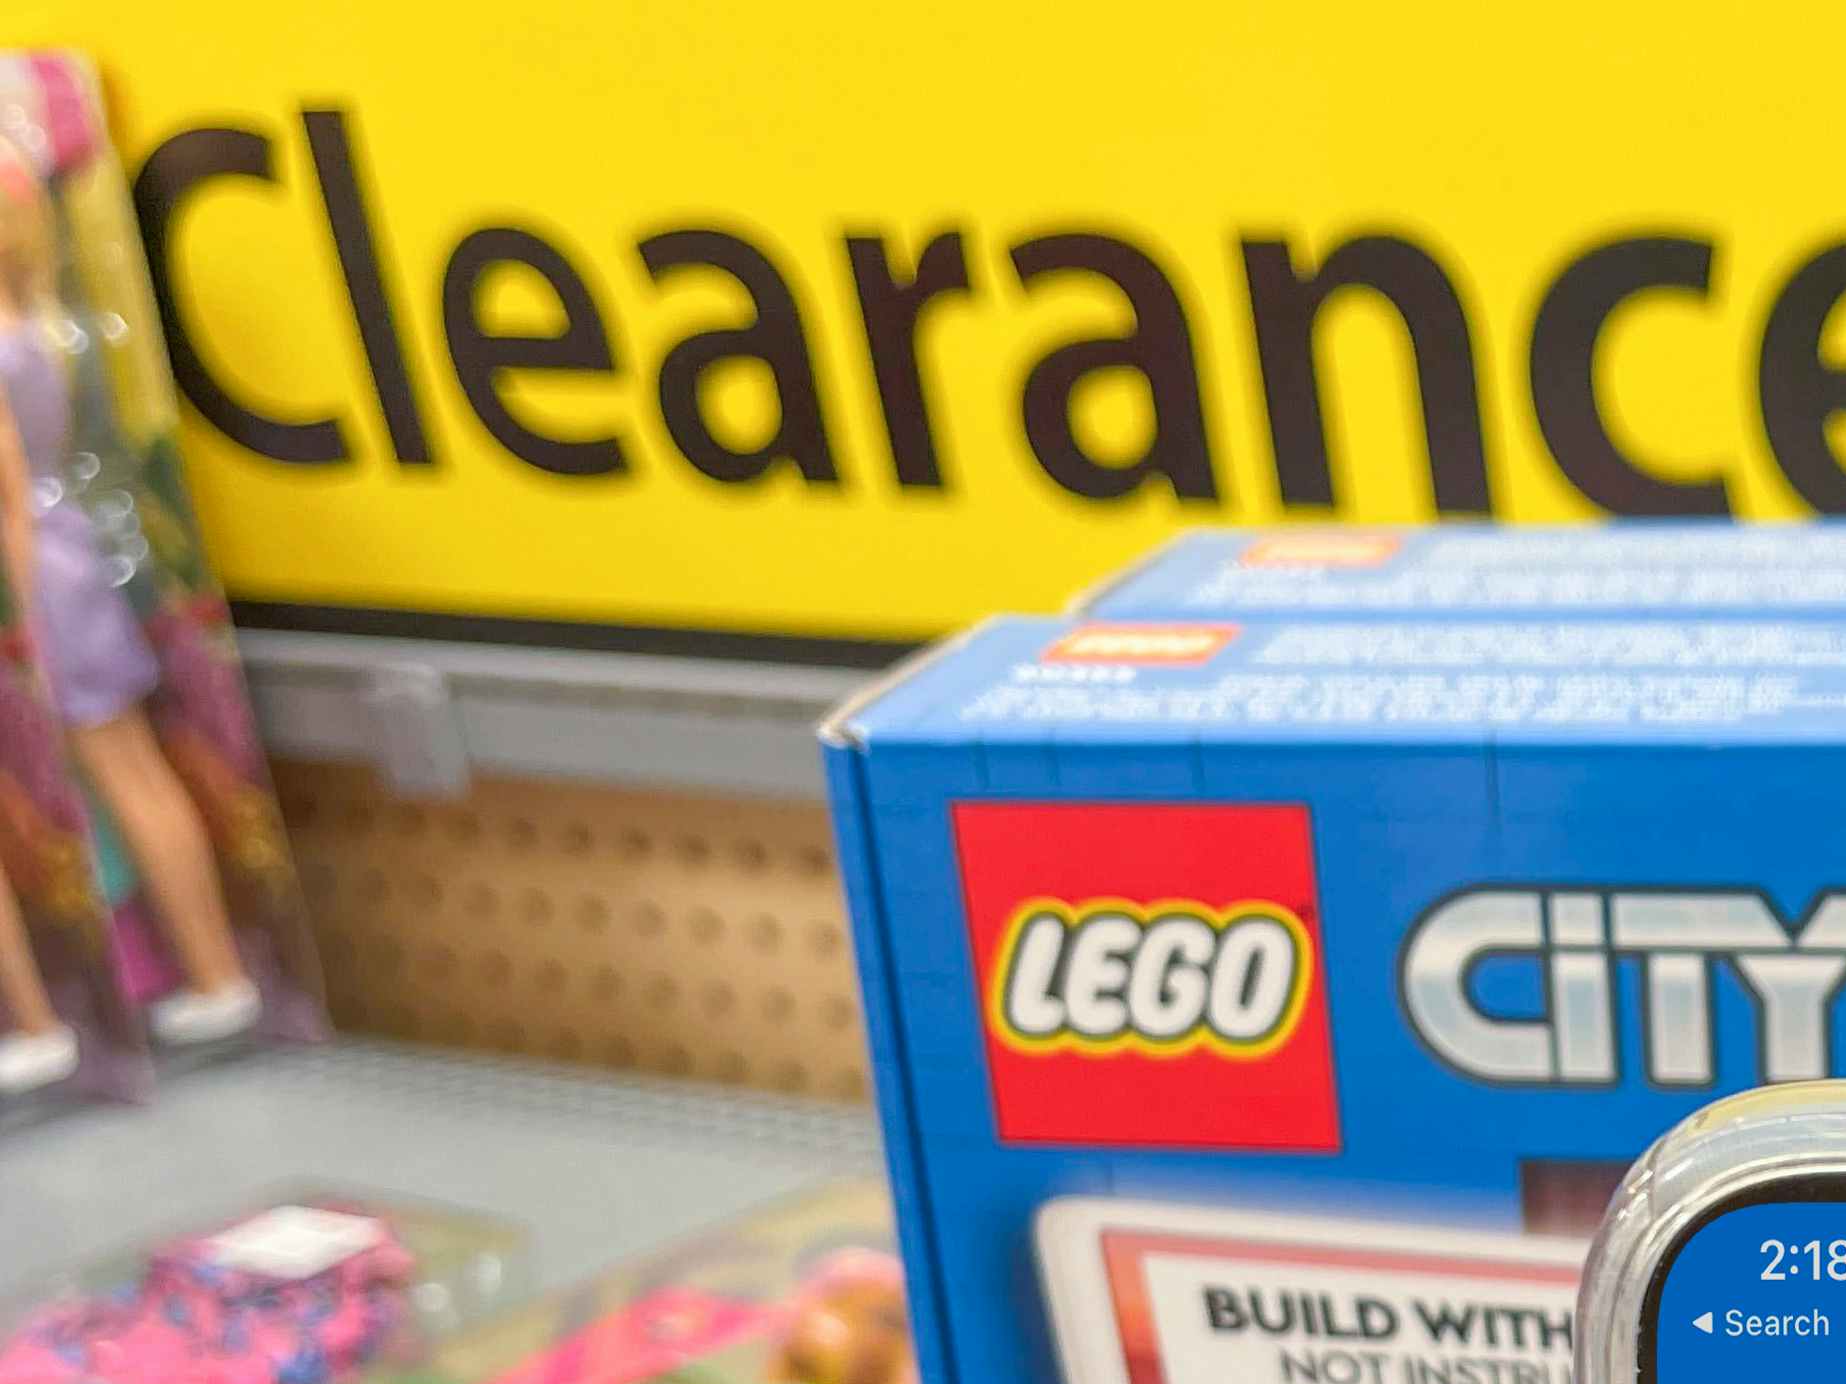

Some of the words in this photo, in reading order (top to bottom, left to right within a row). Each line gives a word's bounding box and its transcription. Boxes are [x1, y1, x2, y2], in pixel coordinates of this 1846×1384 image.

[1000, 908, 1300, 1046] LEGO
[1202, 1286, 1398, 1342] BUILD
[1414, 1298, 1572, 1354] WITH
[1725, 1309, 1830, 1337] Search
